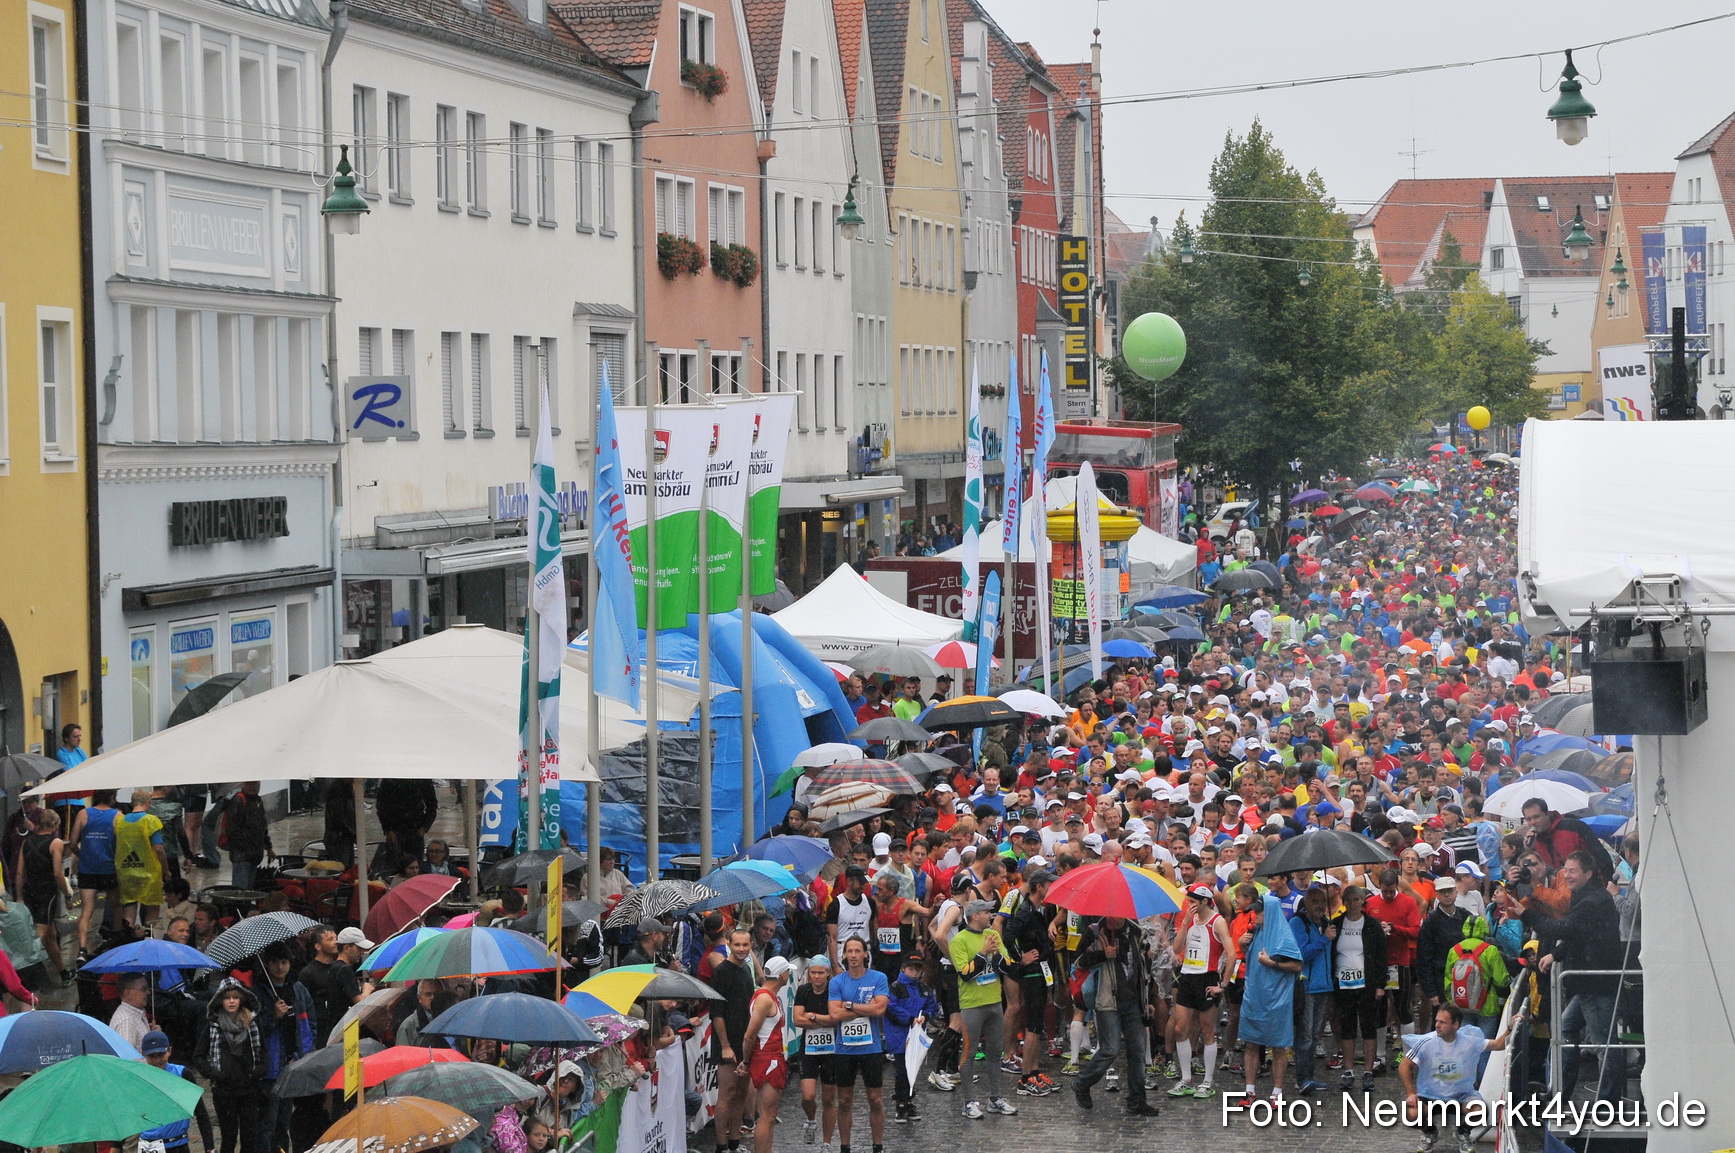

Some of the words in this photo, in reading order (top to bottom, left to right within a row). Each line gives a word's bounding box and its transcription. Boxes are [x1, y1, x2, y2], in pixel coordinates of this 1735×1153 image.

[170, 209, 218, 250] BRILLEN
[218, 215, 262, 256] WEBER
[1062, 240, 1088, 386] HOTEL
[181, 499, 238, 545] BRILLEN
[239, 496, 290, 540] WEBER
[232, 623, 250, 643] BRILLEN
[250, 620, 270, 640] WEBER
[172, 632, 193, 653] BRILLEN
[193, 629, 214, 649] WEBER
[1315, 717, 1327, 725] 282
[1188, 949, 1198, 959] 11
[1340, 970, 1362, 981] 2810
[843, 1023, 869, 1036] 2597
[807, 1033, 832, 1046] 2389
